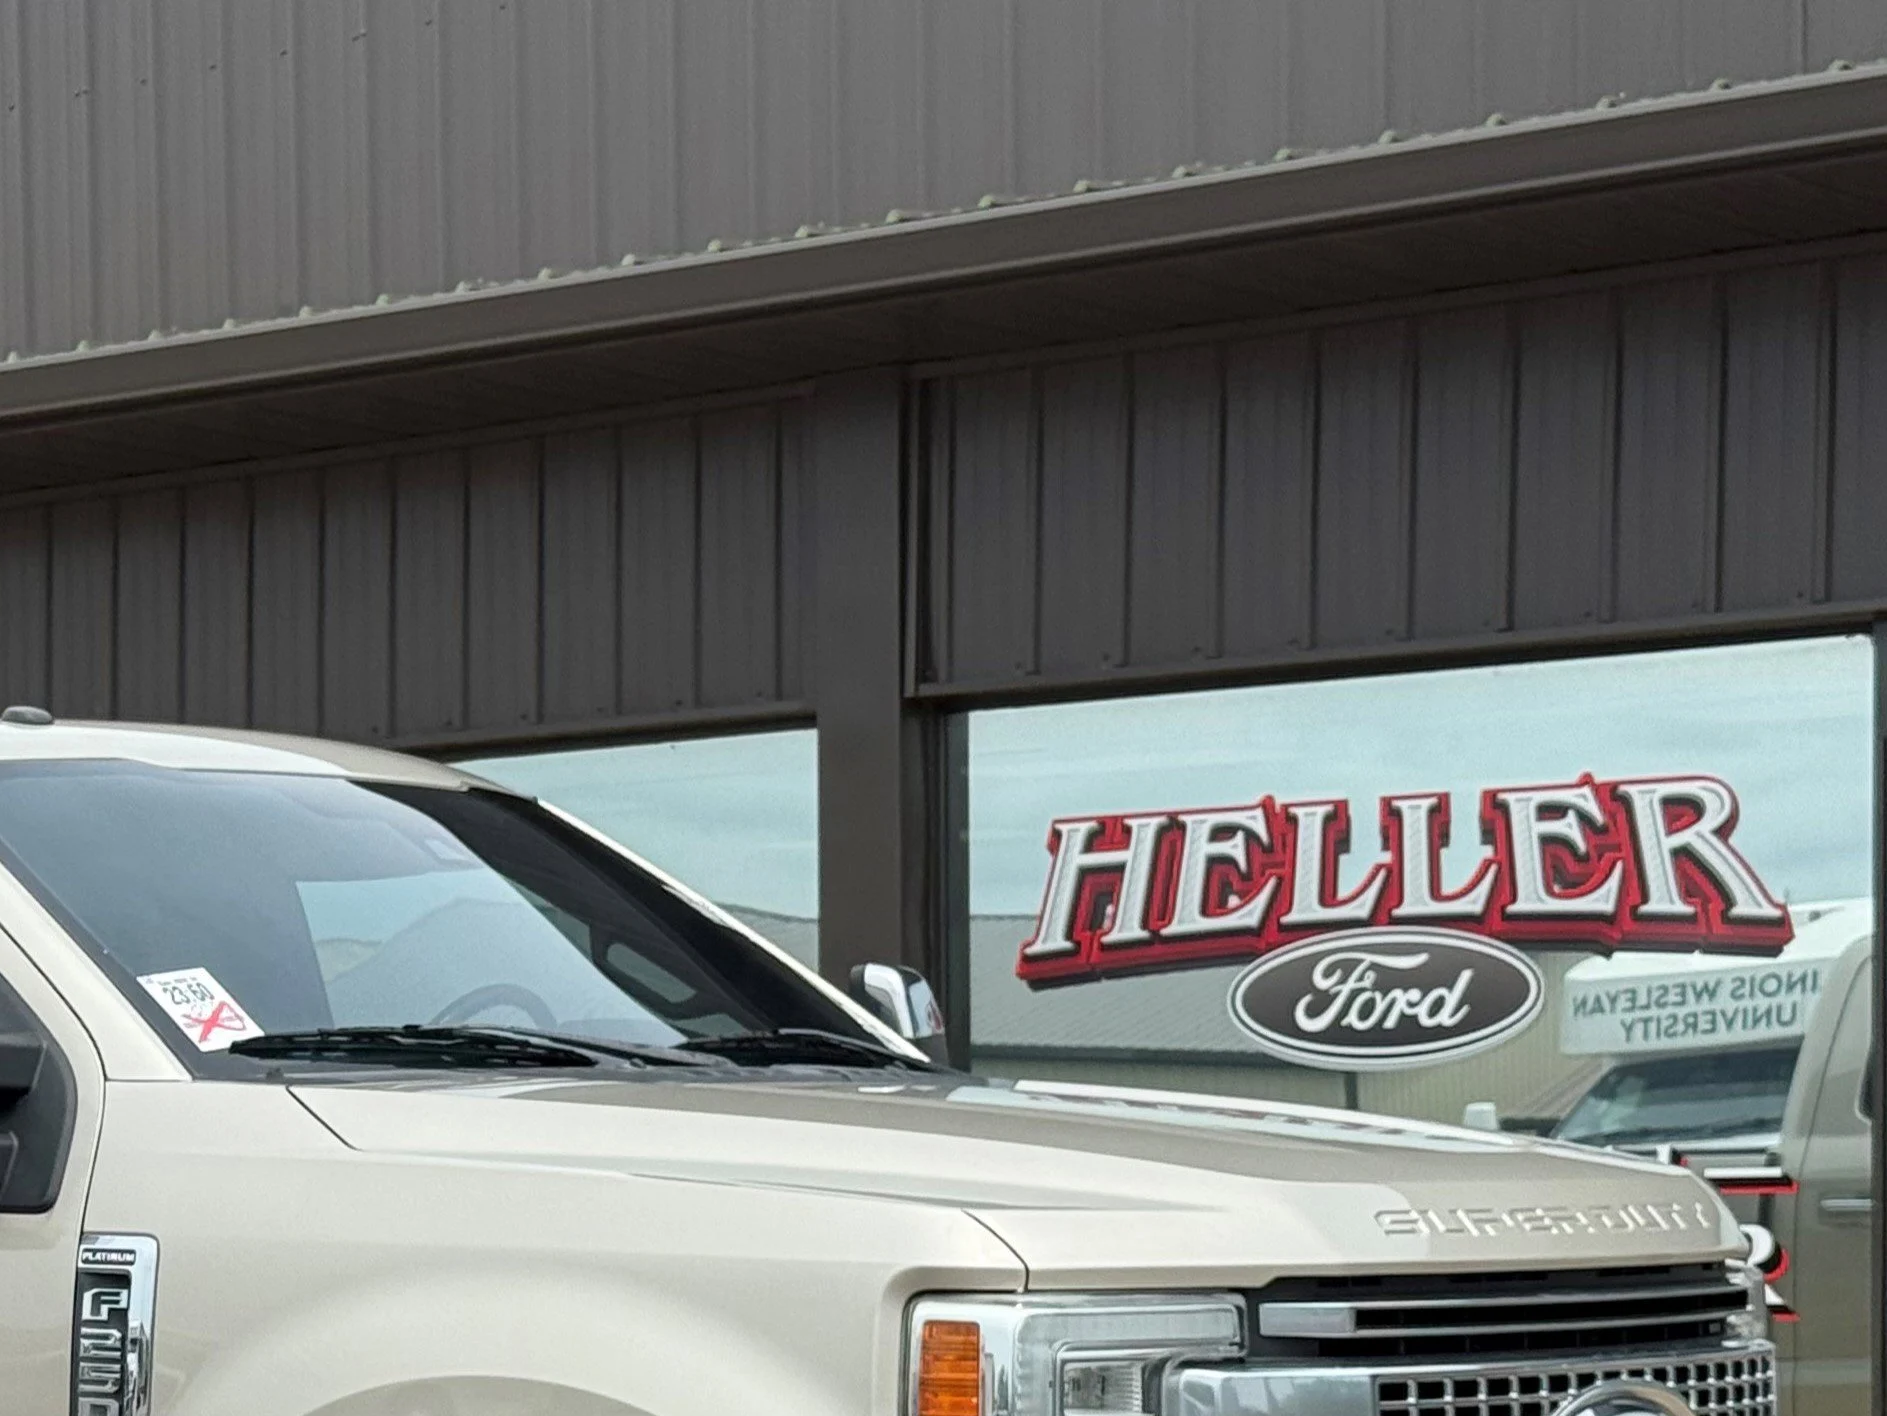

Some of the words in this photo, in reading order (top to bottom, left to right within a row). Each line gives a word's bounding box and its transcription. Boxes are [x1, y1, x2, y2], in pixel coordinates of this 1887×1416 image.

[1016, 772, 1795, 990] HELLER
[1294, 952, 1474, 1032] Ford
[82, 1250, 135, 1264] PLATINUM
